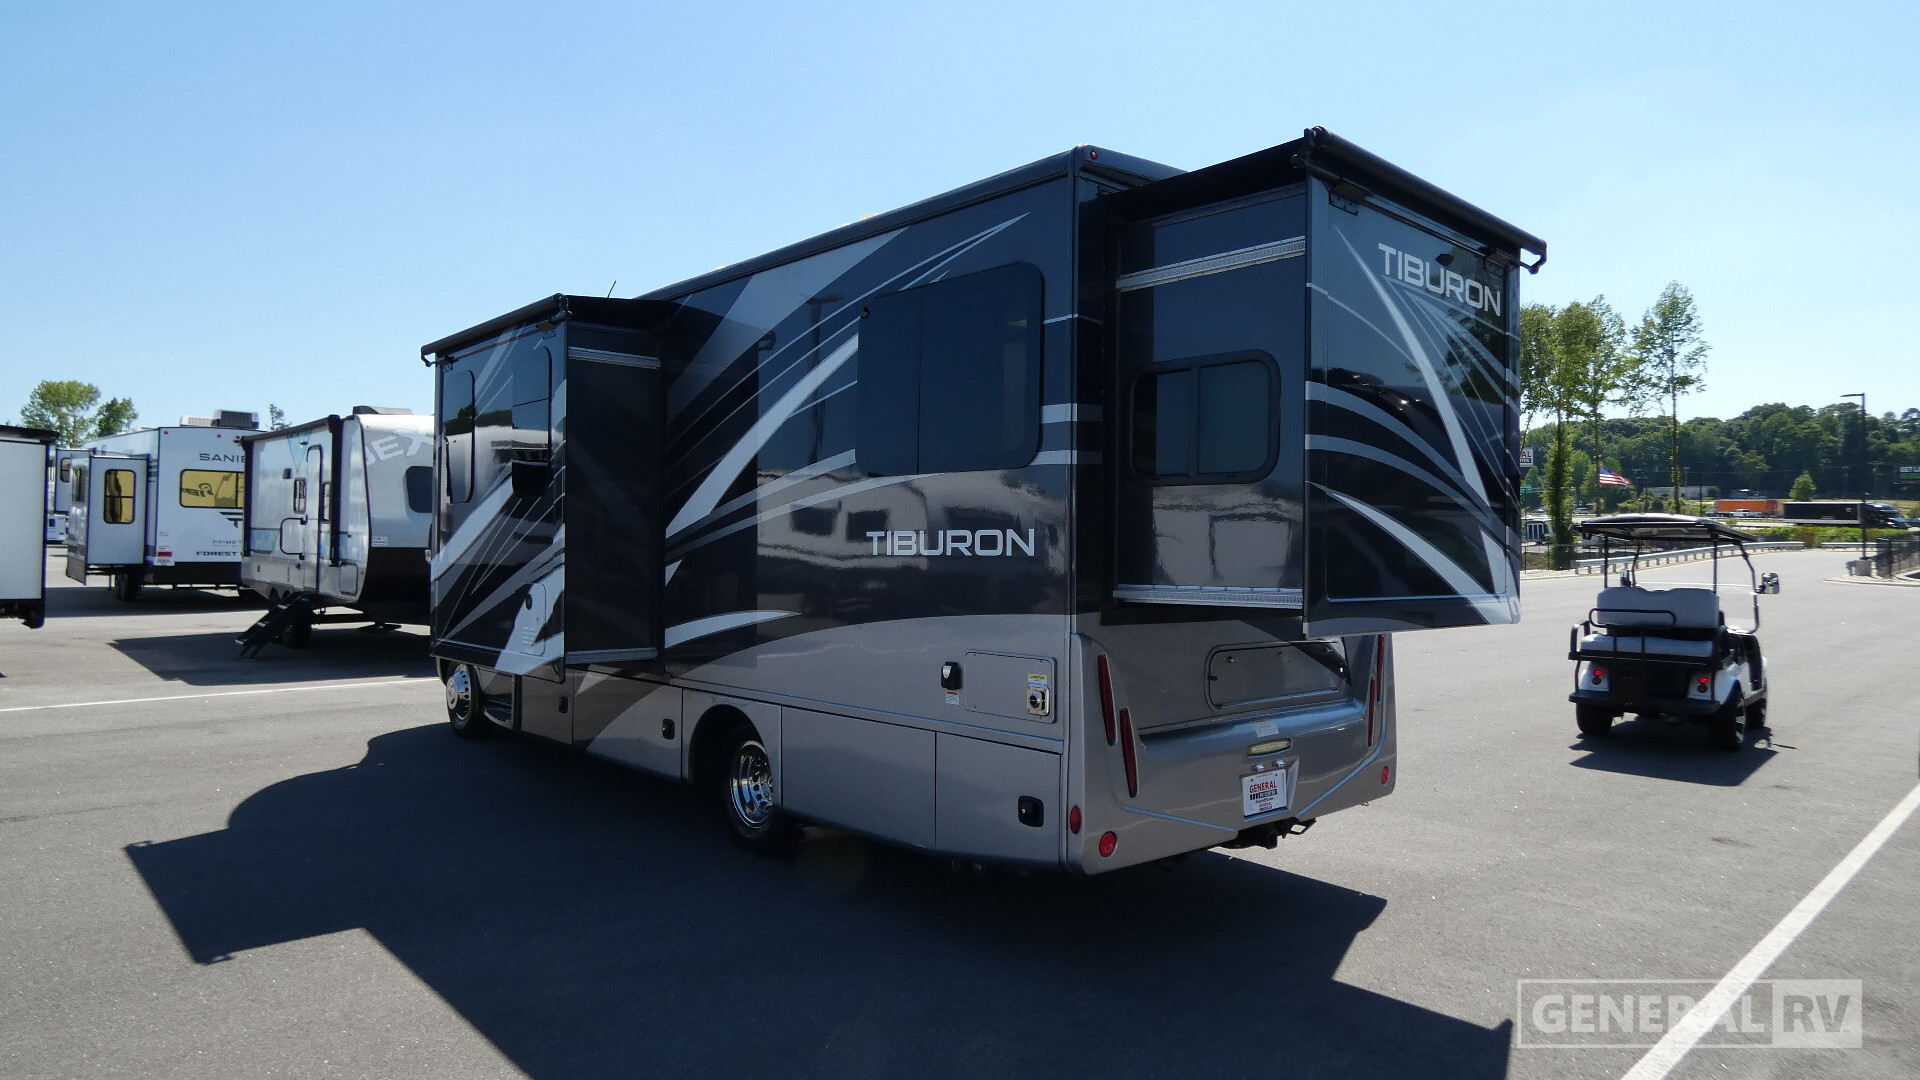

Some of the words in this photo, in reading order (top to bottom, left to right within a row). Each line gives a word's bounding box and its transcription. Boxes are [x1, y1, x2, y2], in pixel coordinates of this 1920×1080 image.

[1378, 242, 1501, 317] TIBURON
[866, 528, 1035, 557] TIBURON
[1249, 780, 1277, 794] GENERAL
